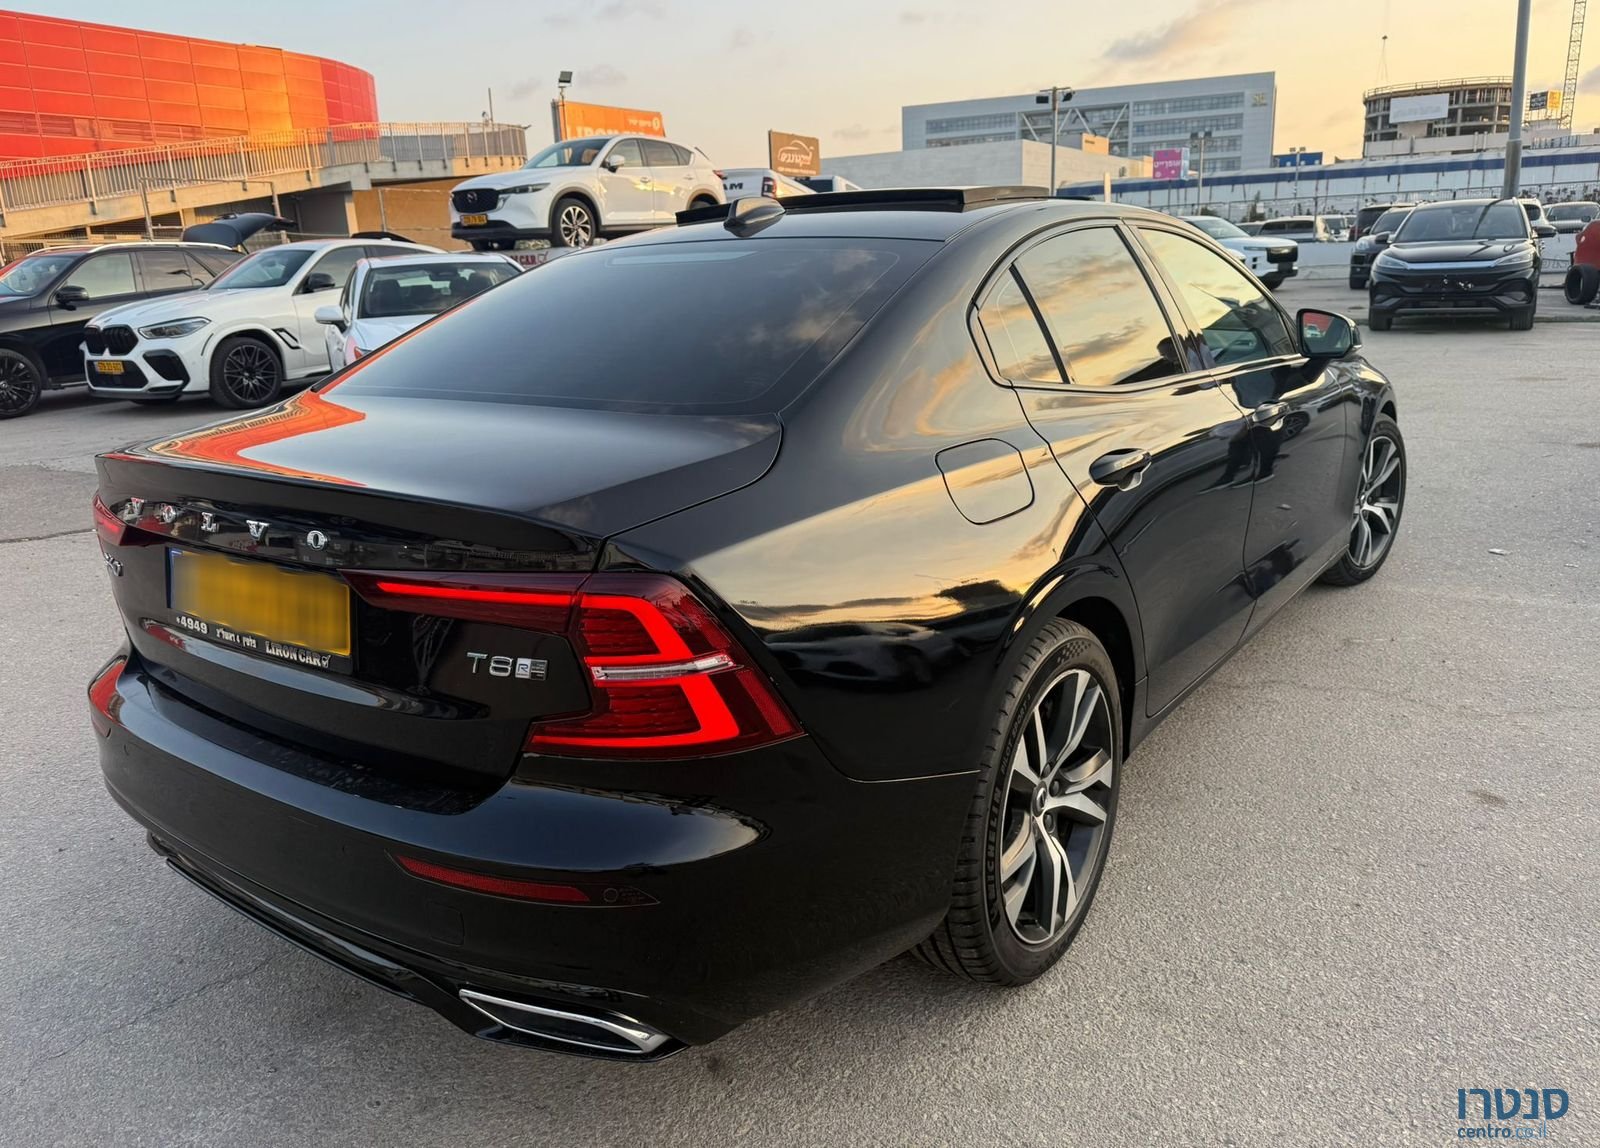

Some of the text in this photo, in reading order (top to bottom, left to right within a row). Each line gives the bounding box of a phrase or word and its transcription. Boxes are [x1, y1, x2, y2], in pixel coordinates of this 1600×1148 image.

[130, 497, 330, 550] VOLVO
[265, 640, 322, 667] LIRON CAR
[466, 652, 513, 677] T8
